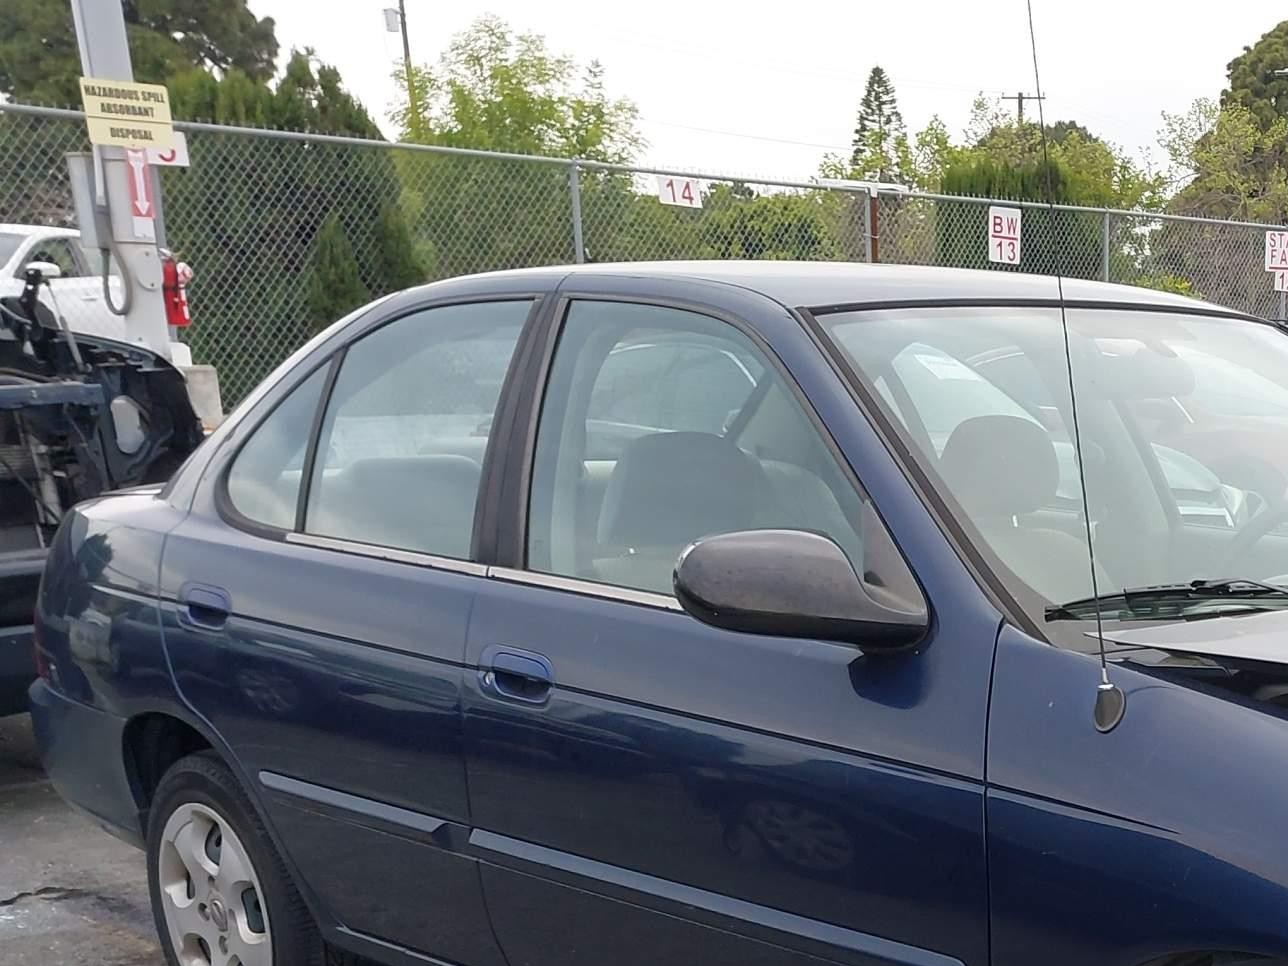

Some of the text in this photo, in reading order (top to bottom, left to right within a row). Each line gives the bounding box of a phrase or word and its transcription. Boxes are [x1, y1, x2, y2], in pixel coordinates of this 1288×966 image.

[83, 85, 166, 103] HAZARDOUS SPILL
[110, 127, 154, 141] DISPOSAL
[666, 179, 694, 206] 14
[993, 215, 1018, 235] BW
[996, 240, 1016, 261] 13
